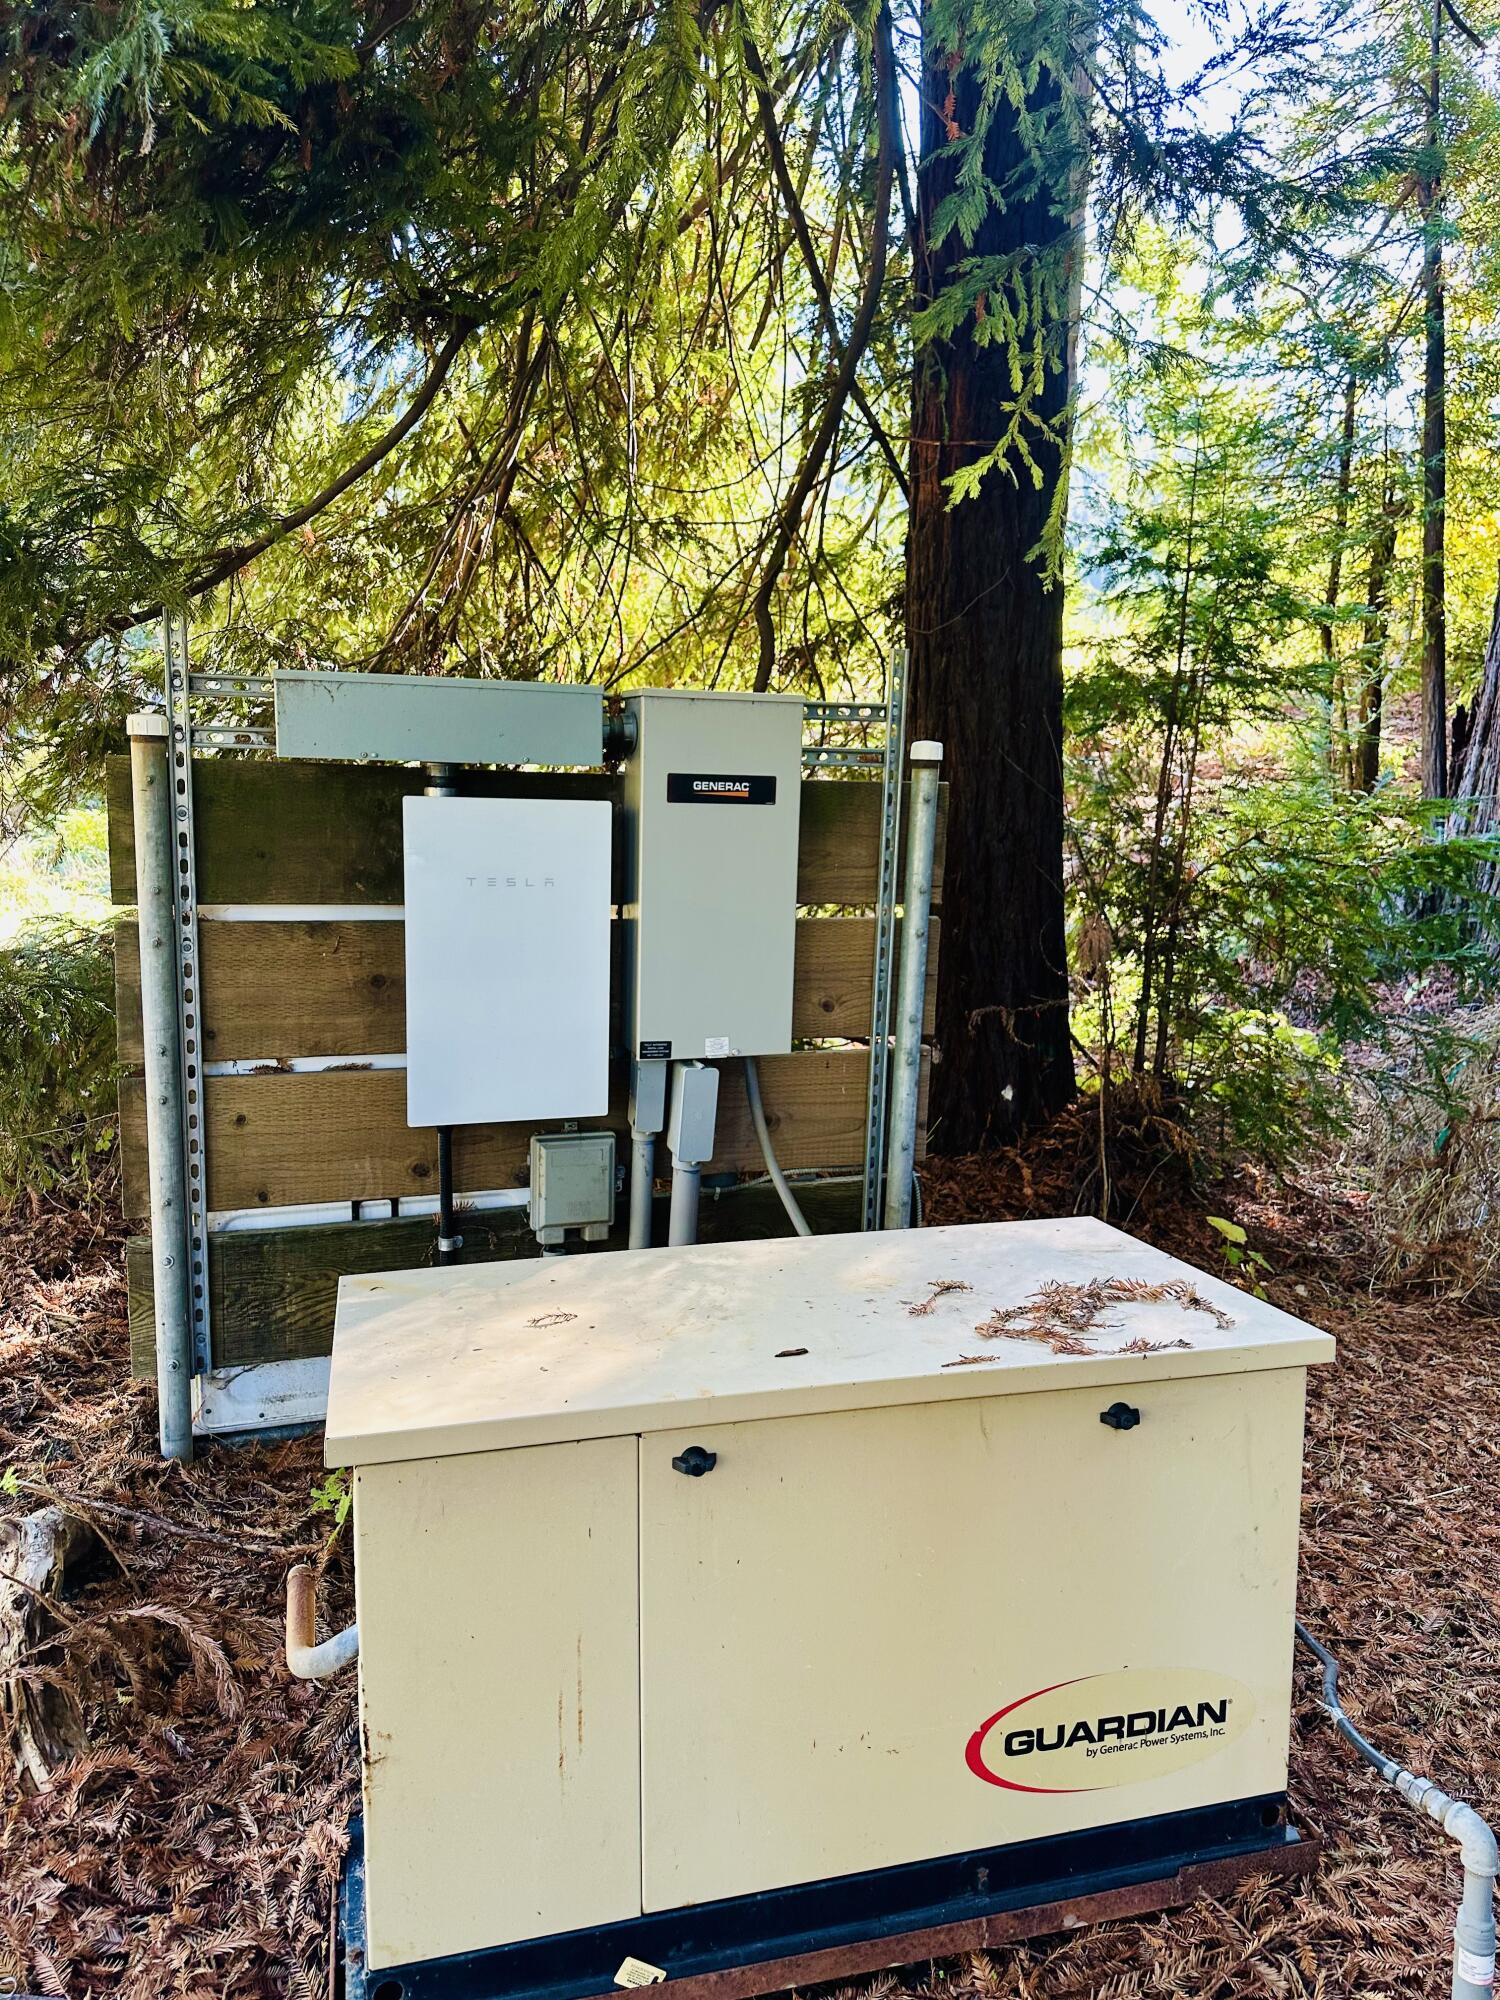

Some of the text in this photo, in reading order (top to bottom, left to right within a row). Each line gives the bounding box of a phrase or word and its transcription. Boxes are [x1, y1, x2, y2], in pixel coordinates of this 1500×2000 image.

[693, 781, 750, 791] GENERAC
[465, 877, 555, 887] TESLA
[1004, 1699, 1227, 1757] GUARDIAN
[1086, 1727, 1226, 1759] by Generac Power Systems, Inc.
